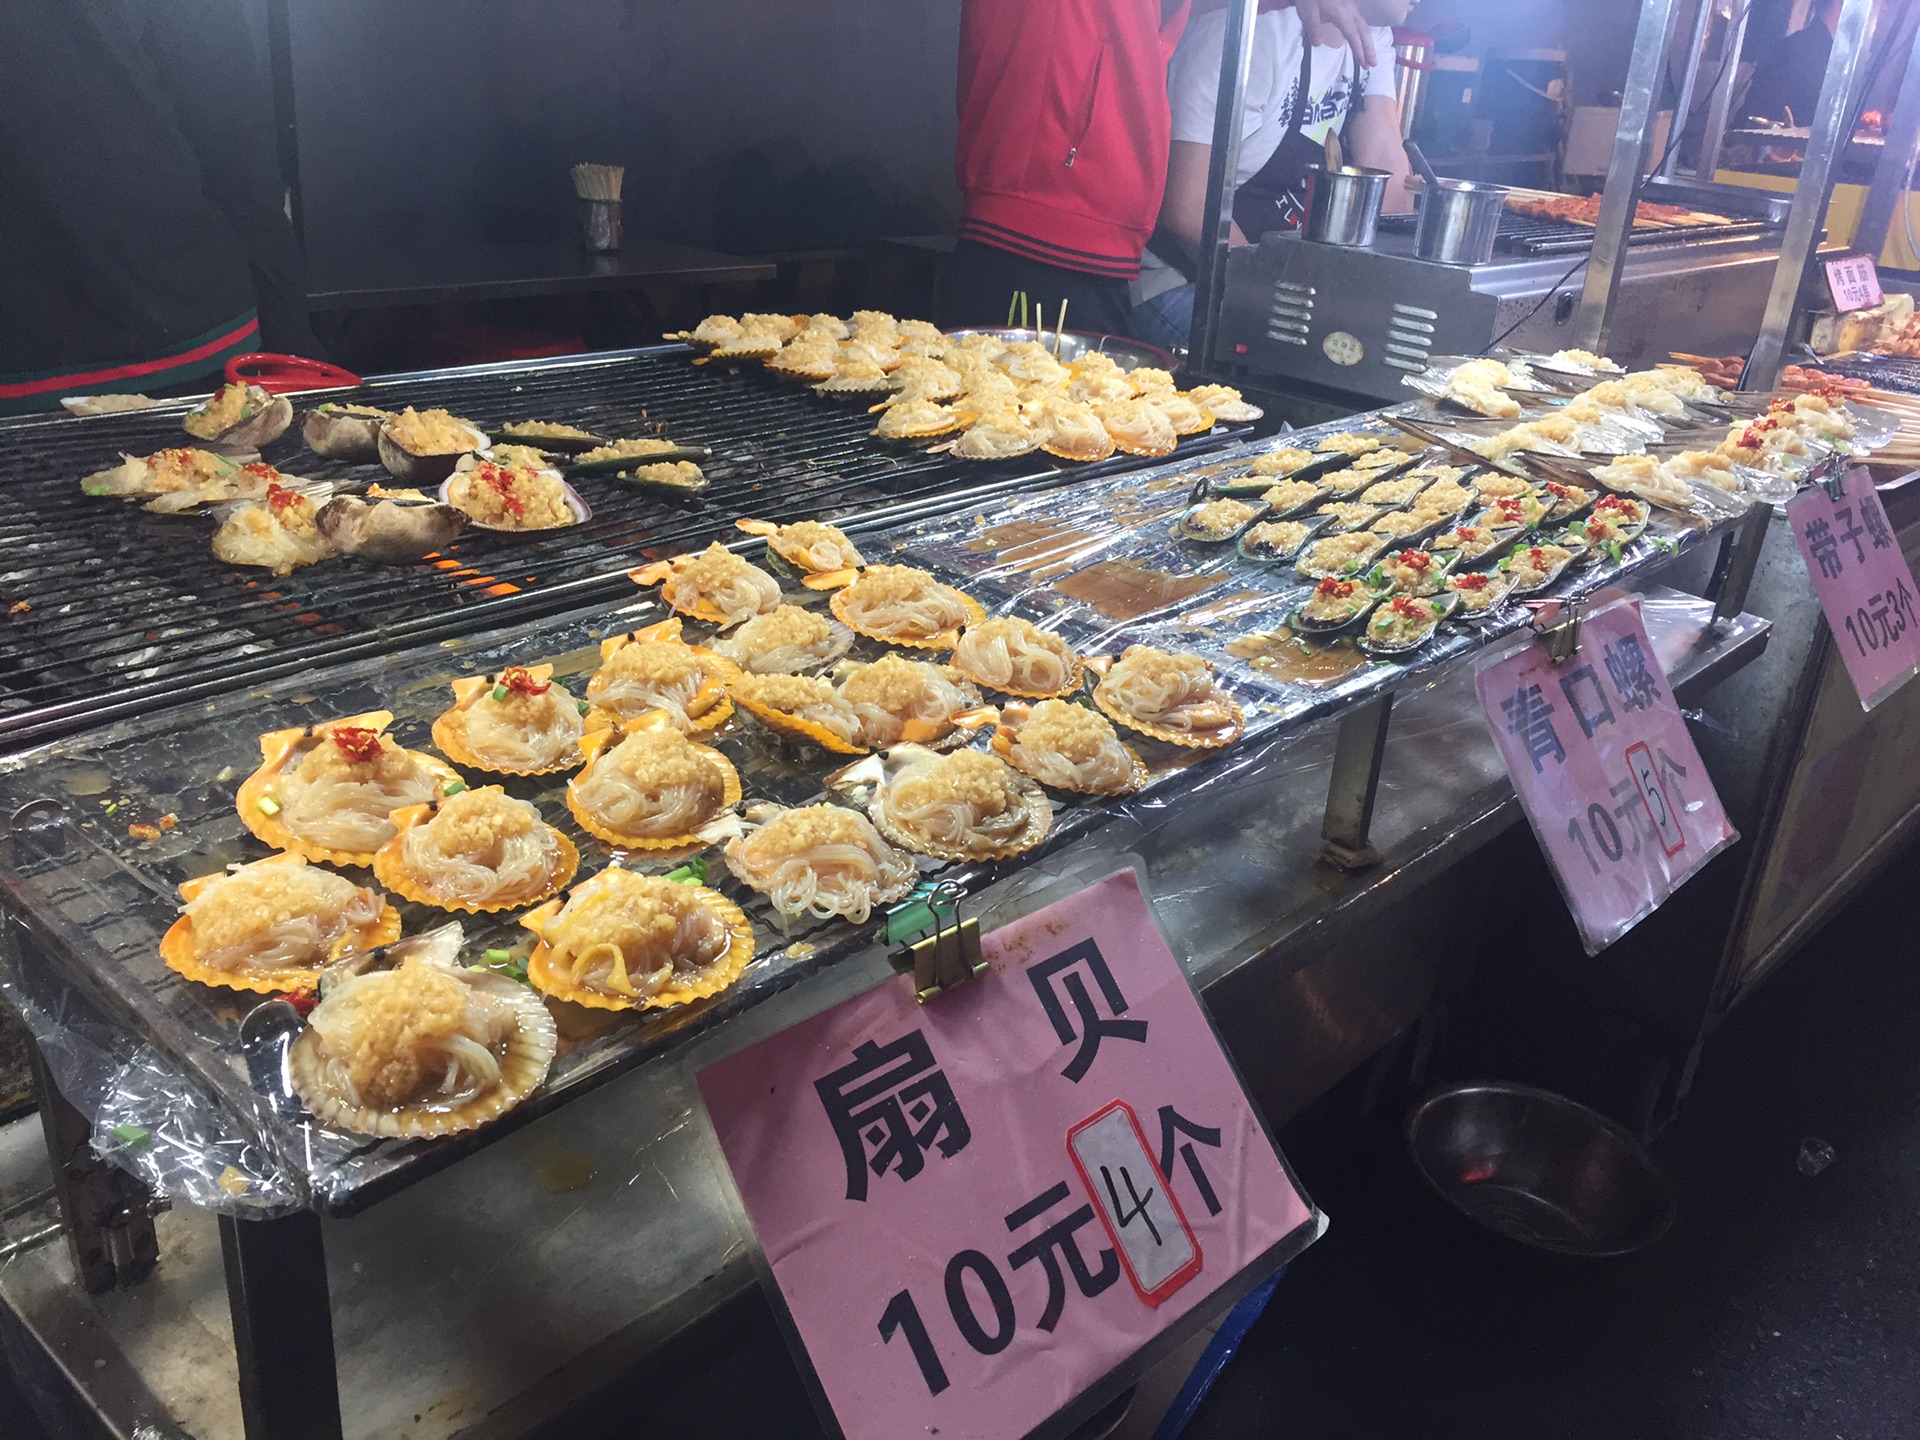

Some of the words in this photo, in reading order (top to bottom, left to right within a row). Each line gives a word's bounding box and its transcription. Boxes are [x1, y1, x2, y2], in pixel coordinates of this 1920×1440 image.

[1804, 496, 1893, 579] 带子螺
[1845, 577, 1919, 658] 10元3个
[1500, 633, 1662, 774] 青口螺
[1567, 747, 1692, 876] 10元5个
[813, 937, 1148, 1202] 扇贝
[877, 1105, 1222, 1397] 10元4个
